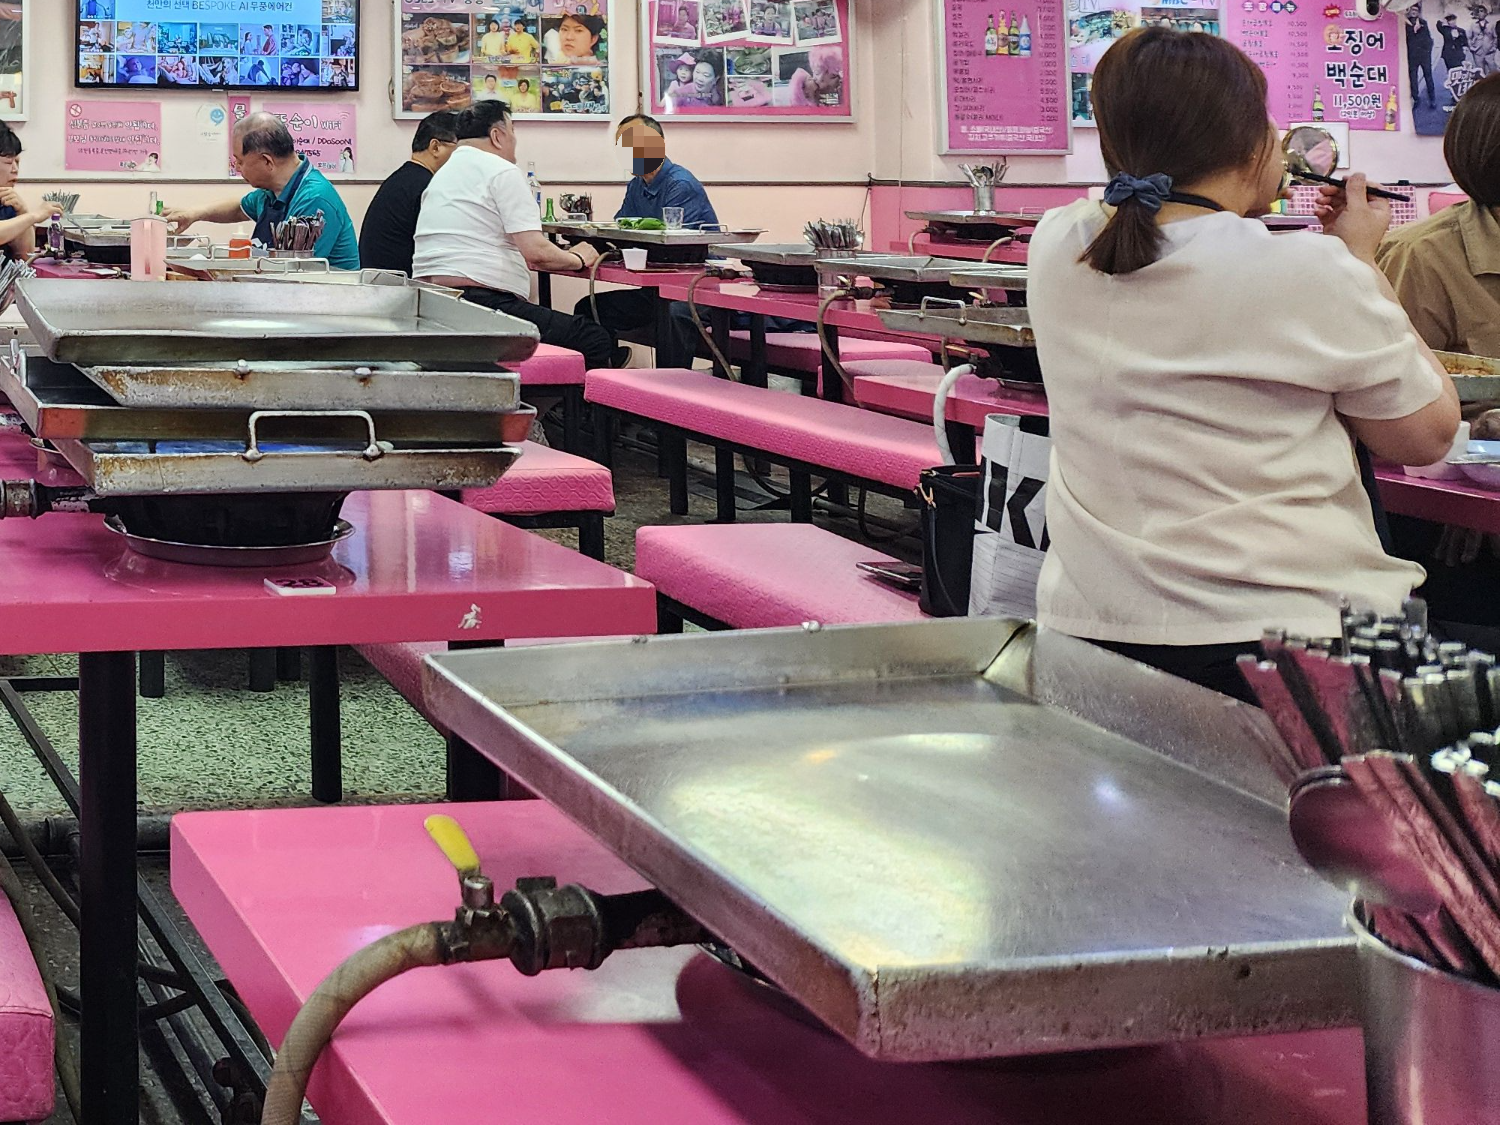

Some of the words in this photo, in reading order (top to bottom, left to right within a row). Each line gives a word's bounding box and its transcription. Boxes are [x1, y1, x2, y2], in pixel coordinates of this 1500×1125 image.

[146, 0, 171, 10] 천만의
[174, 0, 190, 10] 선택
[192, 1, 236, 11] BESPOKE
[238, 1, 249, 11] AI
[250, 1, 293, 12] 무풍에어컨
[1325, 27, 1384, 55] 오징어
[1326, 61, 1388, 88] 백순대
[1333, 94, 1382, 109] 11,500원
[320, 120, 341, 131] WiFi
